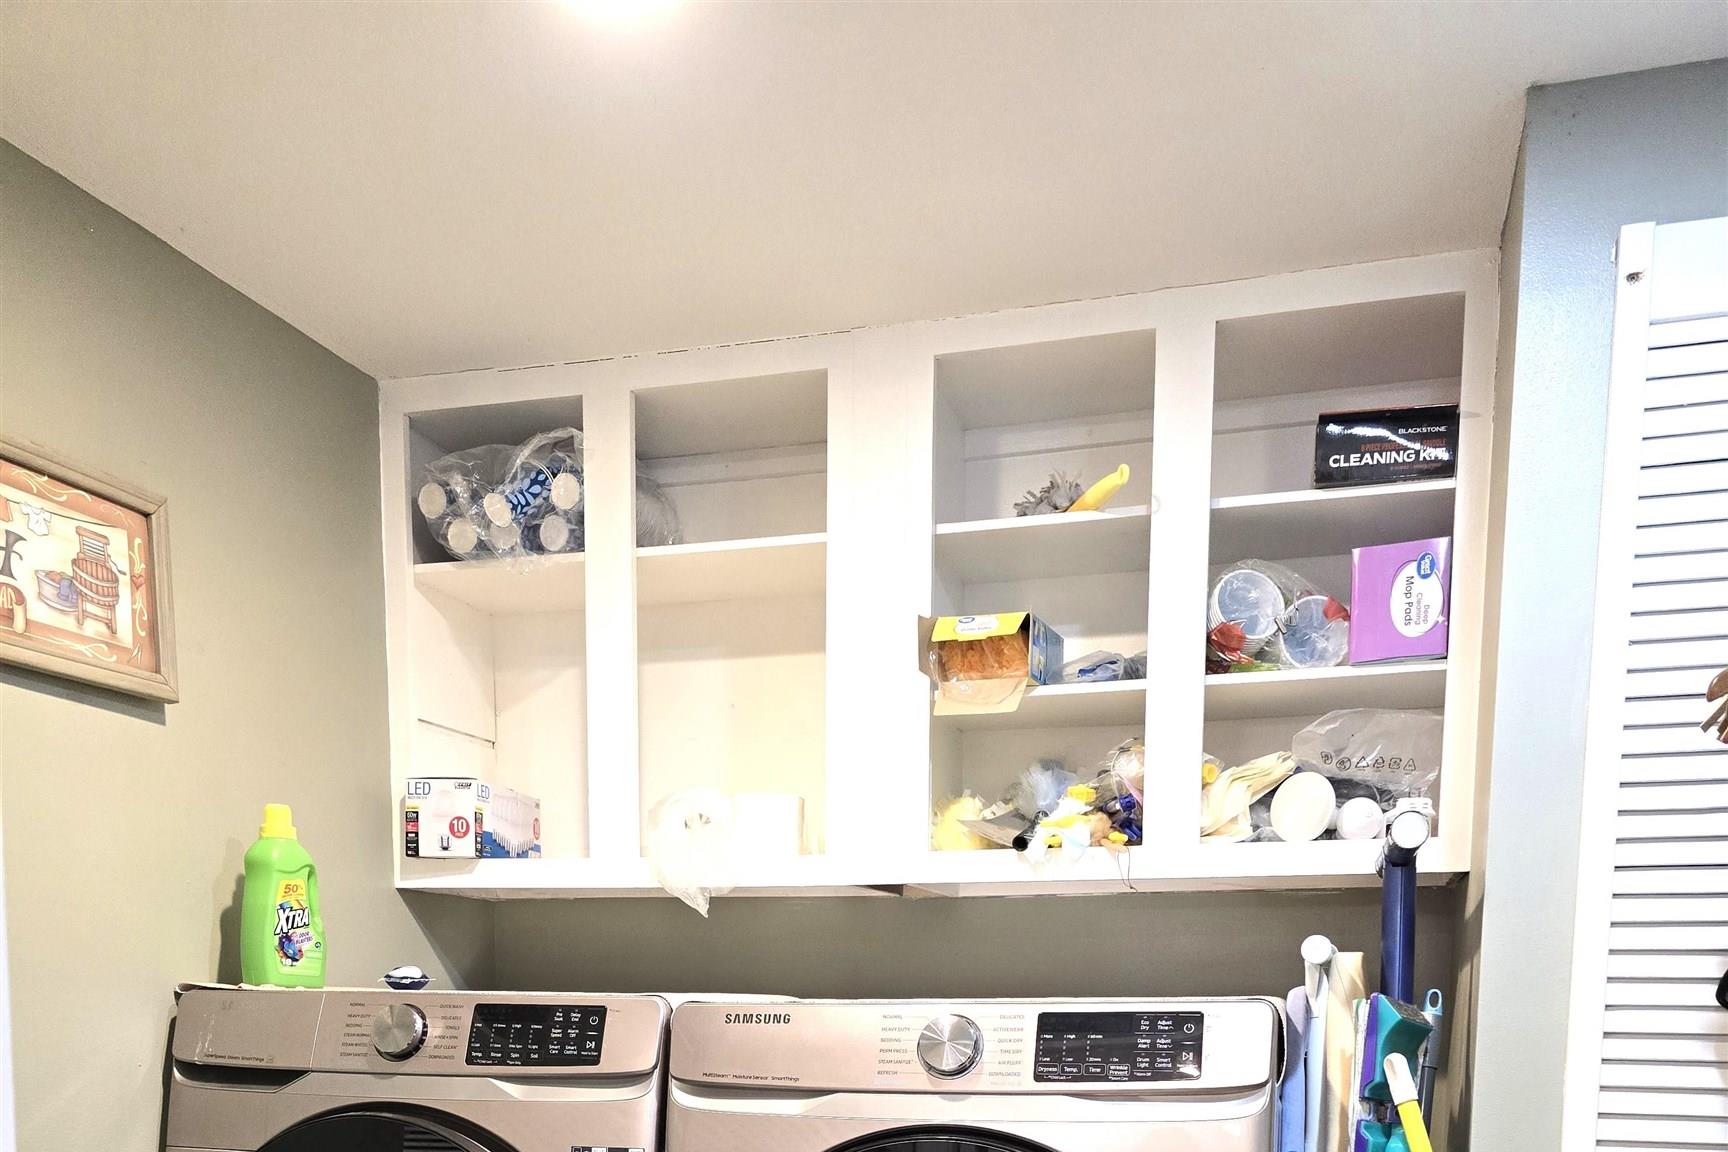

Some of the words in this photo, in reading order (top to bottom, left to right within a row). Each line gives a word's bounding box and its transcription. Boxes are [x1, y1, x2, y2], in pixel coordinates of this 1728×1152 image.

[1398, 425, 1448, 435] BLACKSTONE
[1328, 449, 1416, 468] CLEANING
[1403, 575, 1415, 599] Mop
[1403, 601, 1414, 626] Pads
[1414, 592, 1423, 625] Cleaning
[407, 781, 431, 796] LED
[476, 783, 490, 800] LED
[451, 818, 467, 833] 10
[274, 907, 310, 935] XTRA
[724, 1012, 791, 1025] SAMSUNG
